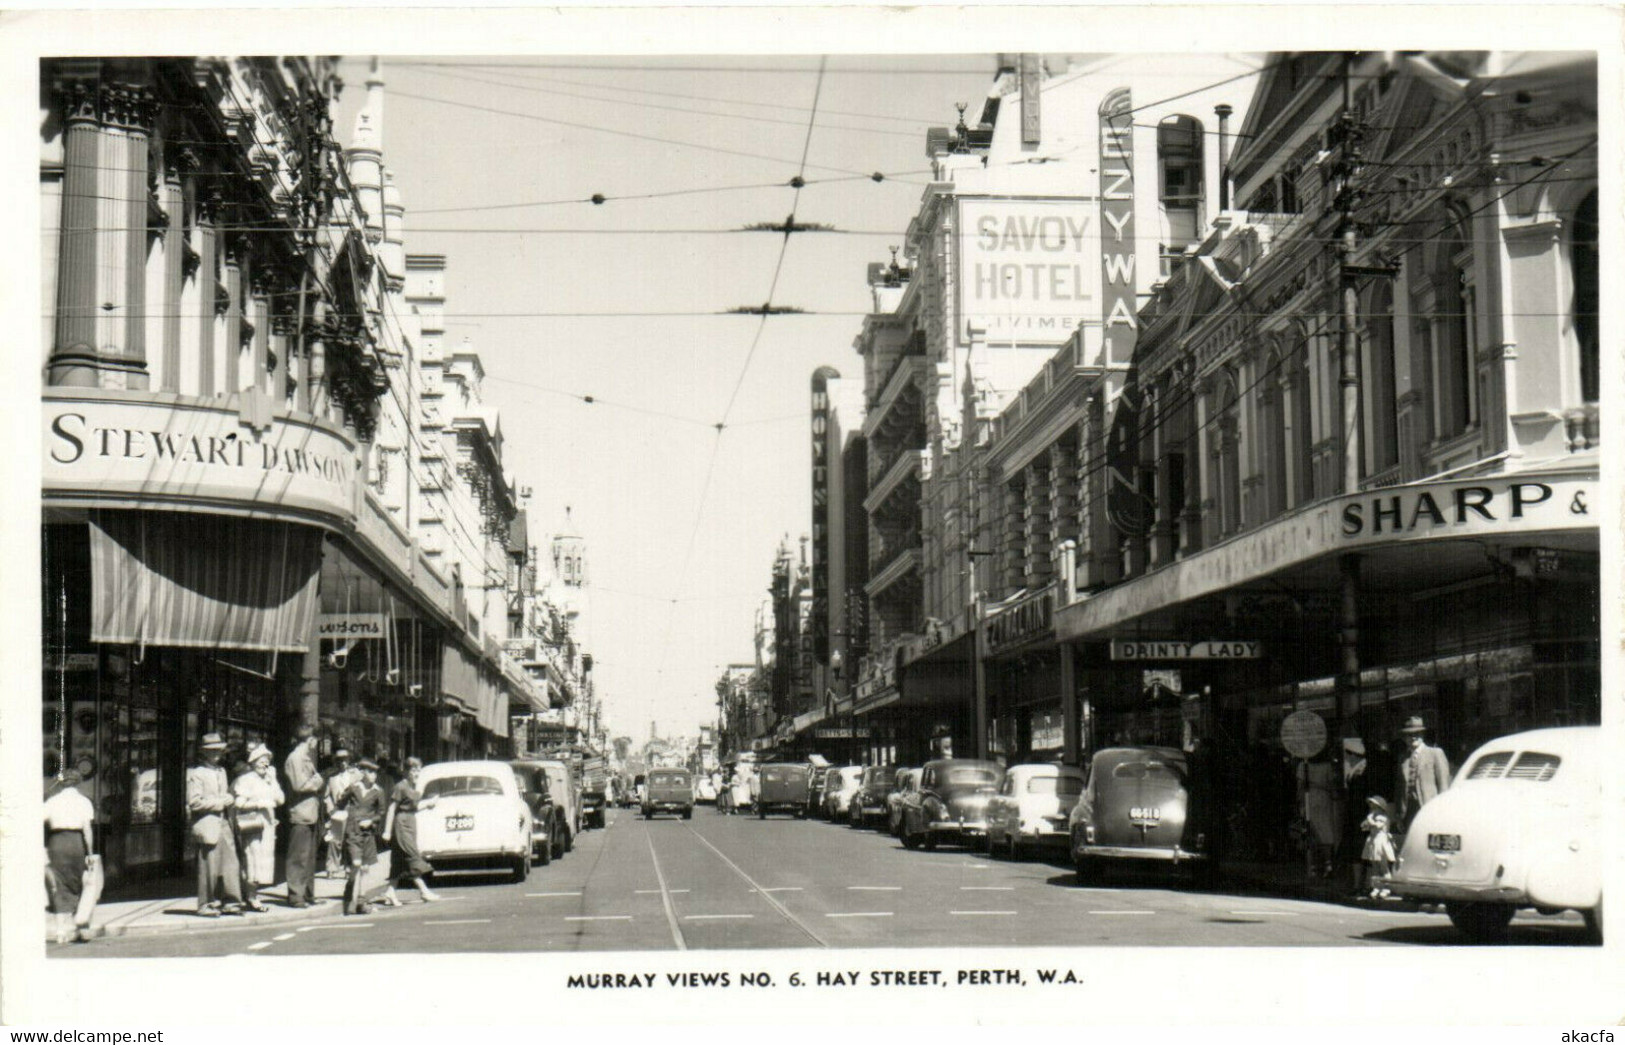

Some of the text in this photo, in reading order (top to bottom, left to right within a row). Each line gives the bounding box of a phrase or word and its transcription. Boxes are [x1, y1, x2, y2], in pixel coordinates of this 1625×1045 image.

[977, 215, 1090, 253] SAVOY
[975, 263, 1092, 301] HOTEL
[1102, 126, 1140, 494] EZYWALKIN
[1342, 482, 1552, 536] SHARP
[1570, 490, 1588, 515] &
[1124, 643, 1256, 657] DAINTY LADY
